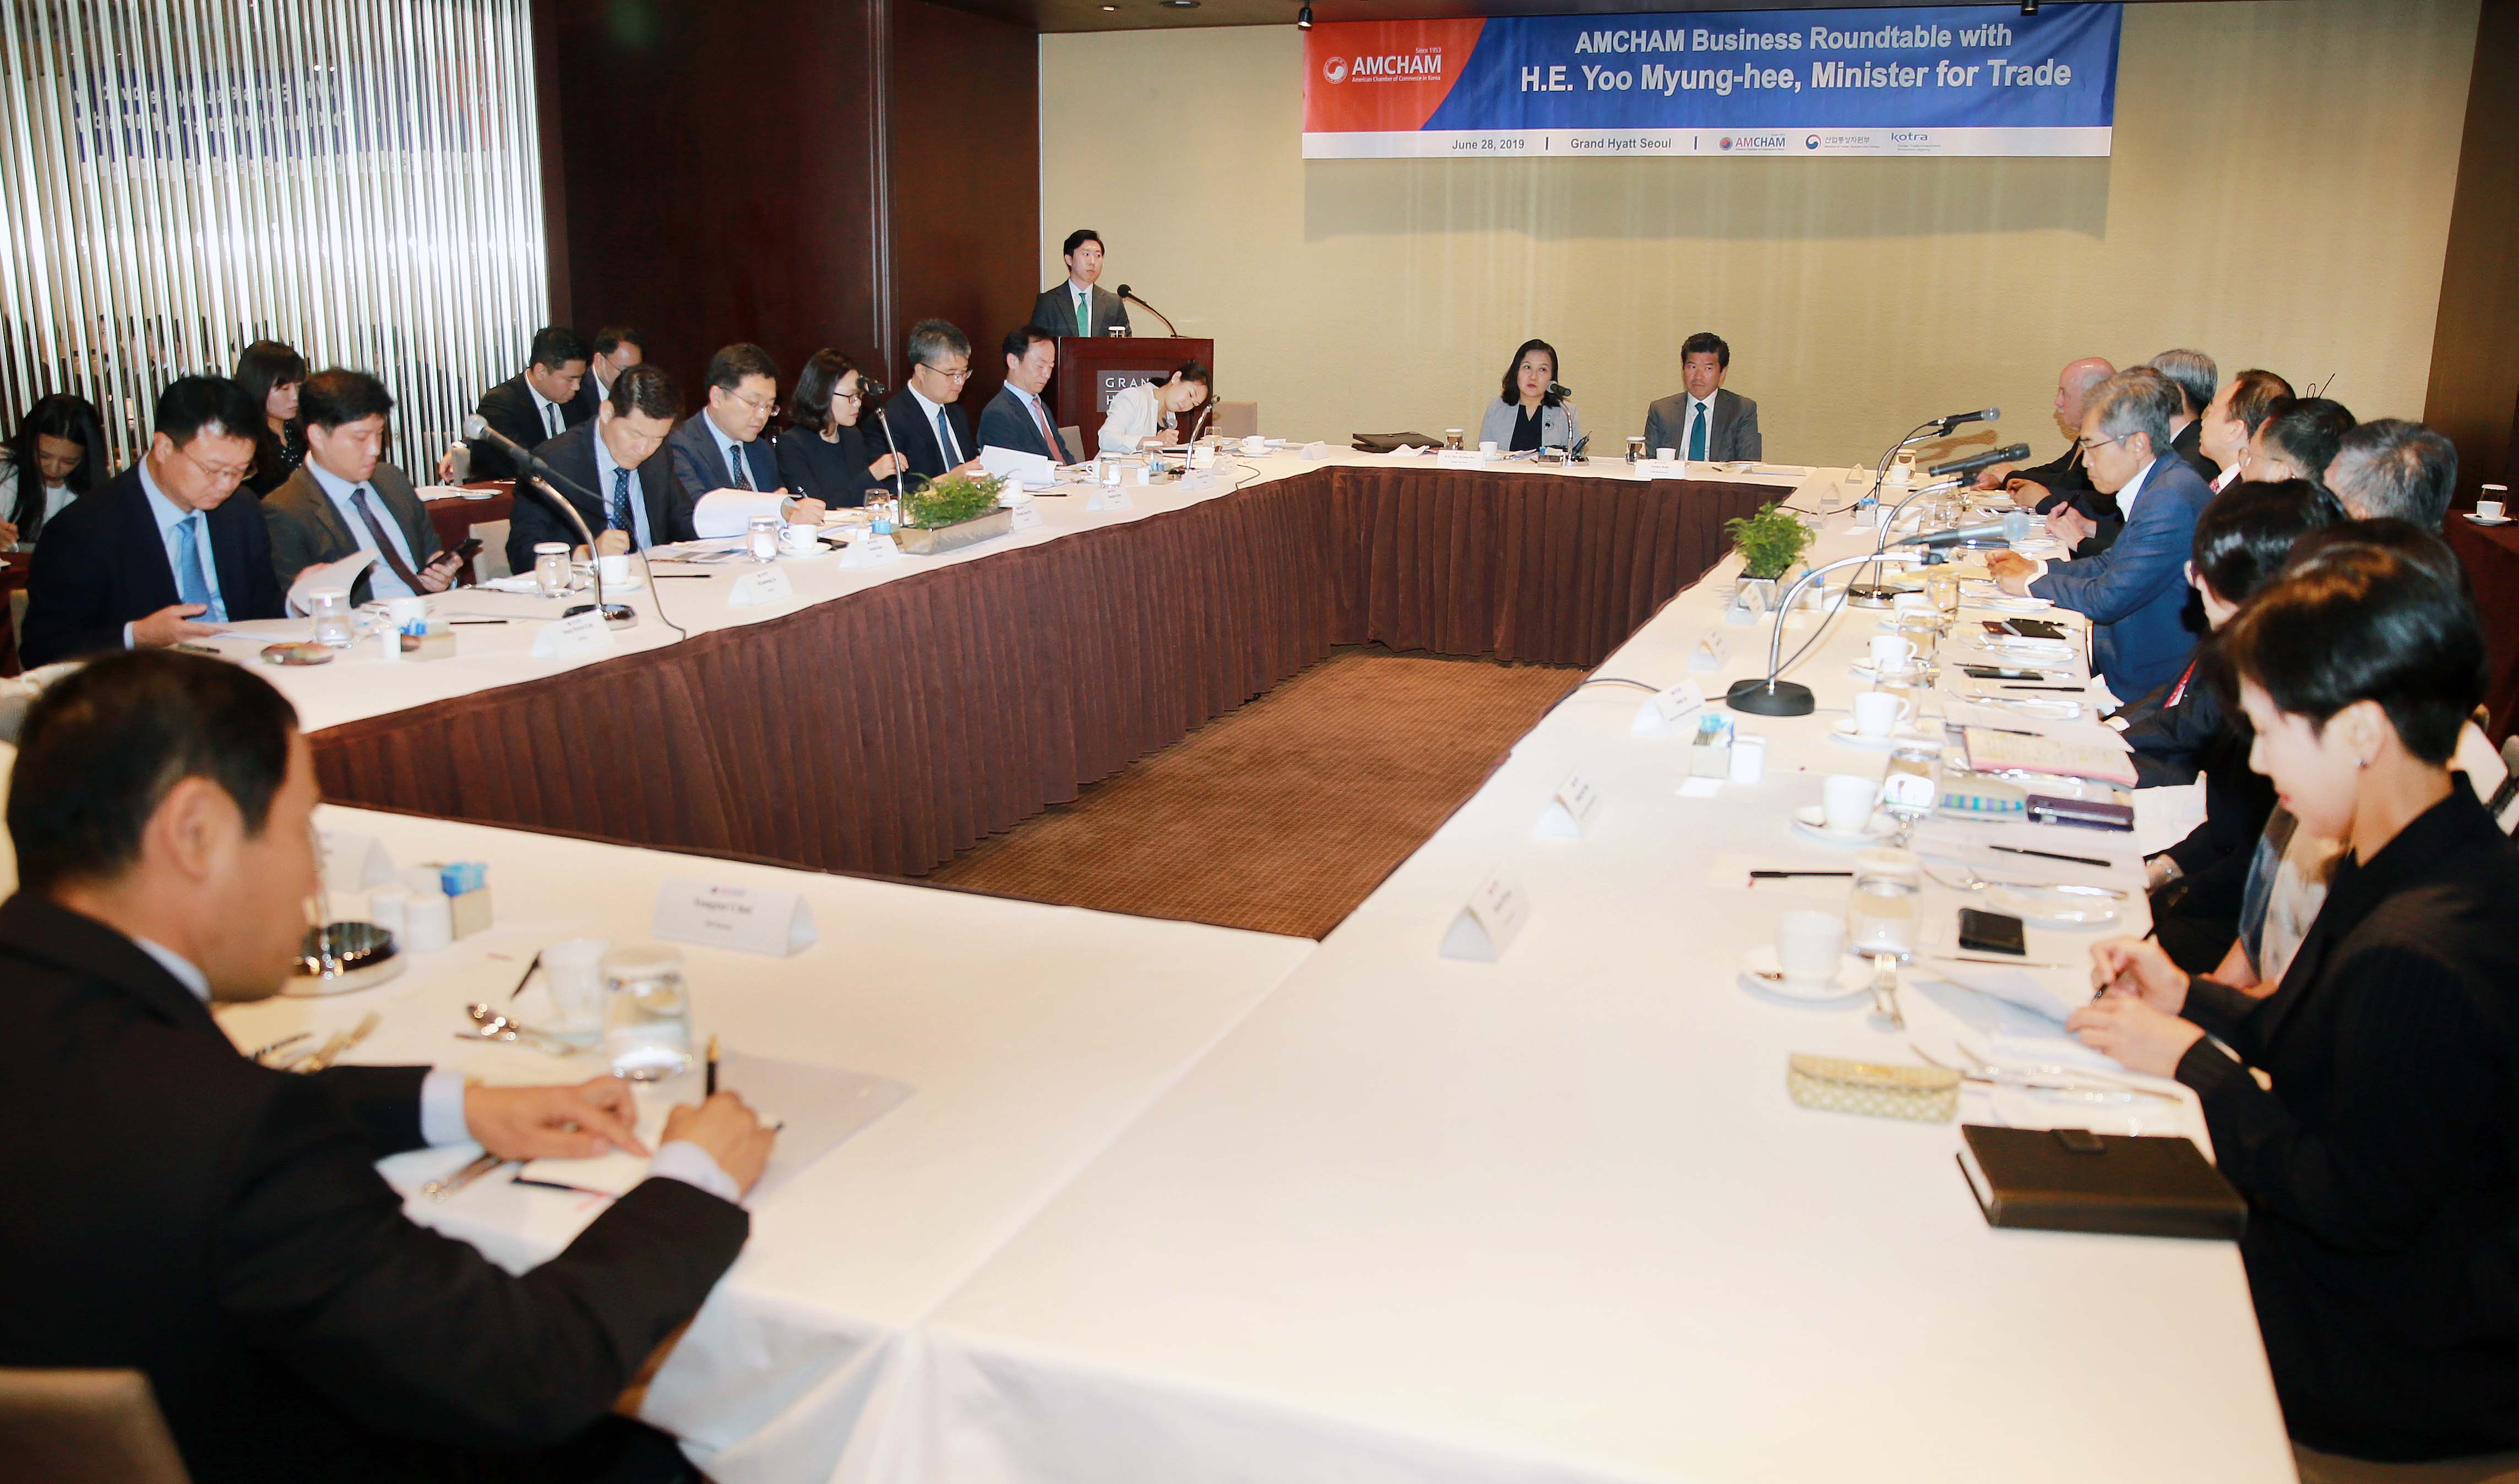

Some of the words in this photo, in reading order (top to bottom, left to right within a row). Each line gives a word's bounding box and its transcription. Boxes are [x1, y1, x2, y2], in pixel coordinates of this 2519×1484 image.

[1574, 29, 1685, 53] AMCHAM
[1692, 28, 1803, 51] Business
[1809, 25, 1952, 50] Roundtable
[1958, 23, 2012, 47] with
[1352, 55, 1441, 75] AMCHAM
[1521, 66, 1574, 92] H.E.
[1581, 65, 1633, 91] Yoo
[1640, 63, 1802, 96] Myung-hee,
[1810, 61, 1929, 89] Minister
[1935, 59, 1980, 88] for
[1986, 58, 2072, 87] Trade
[1735, 137, 1786, 147] AMCHAM
[1891, 132, 1928, 142] kotra
[1452, 139, 1478, 150] June
[1481, 139, 1496, 151] 28,
[1499, 139, 1525, 149] 2019
[1570, 138, 1604, 149] Grand
[1607, 138, 1637, 151] Hyatt
[1640, 138, 1672, 149] Seoul
[1105, 377, 1150, 388] GRAN
